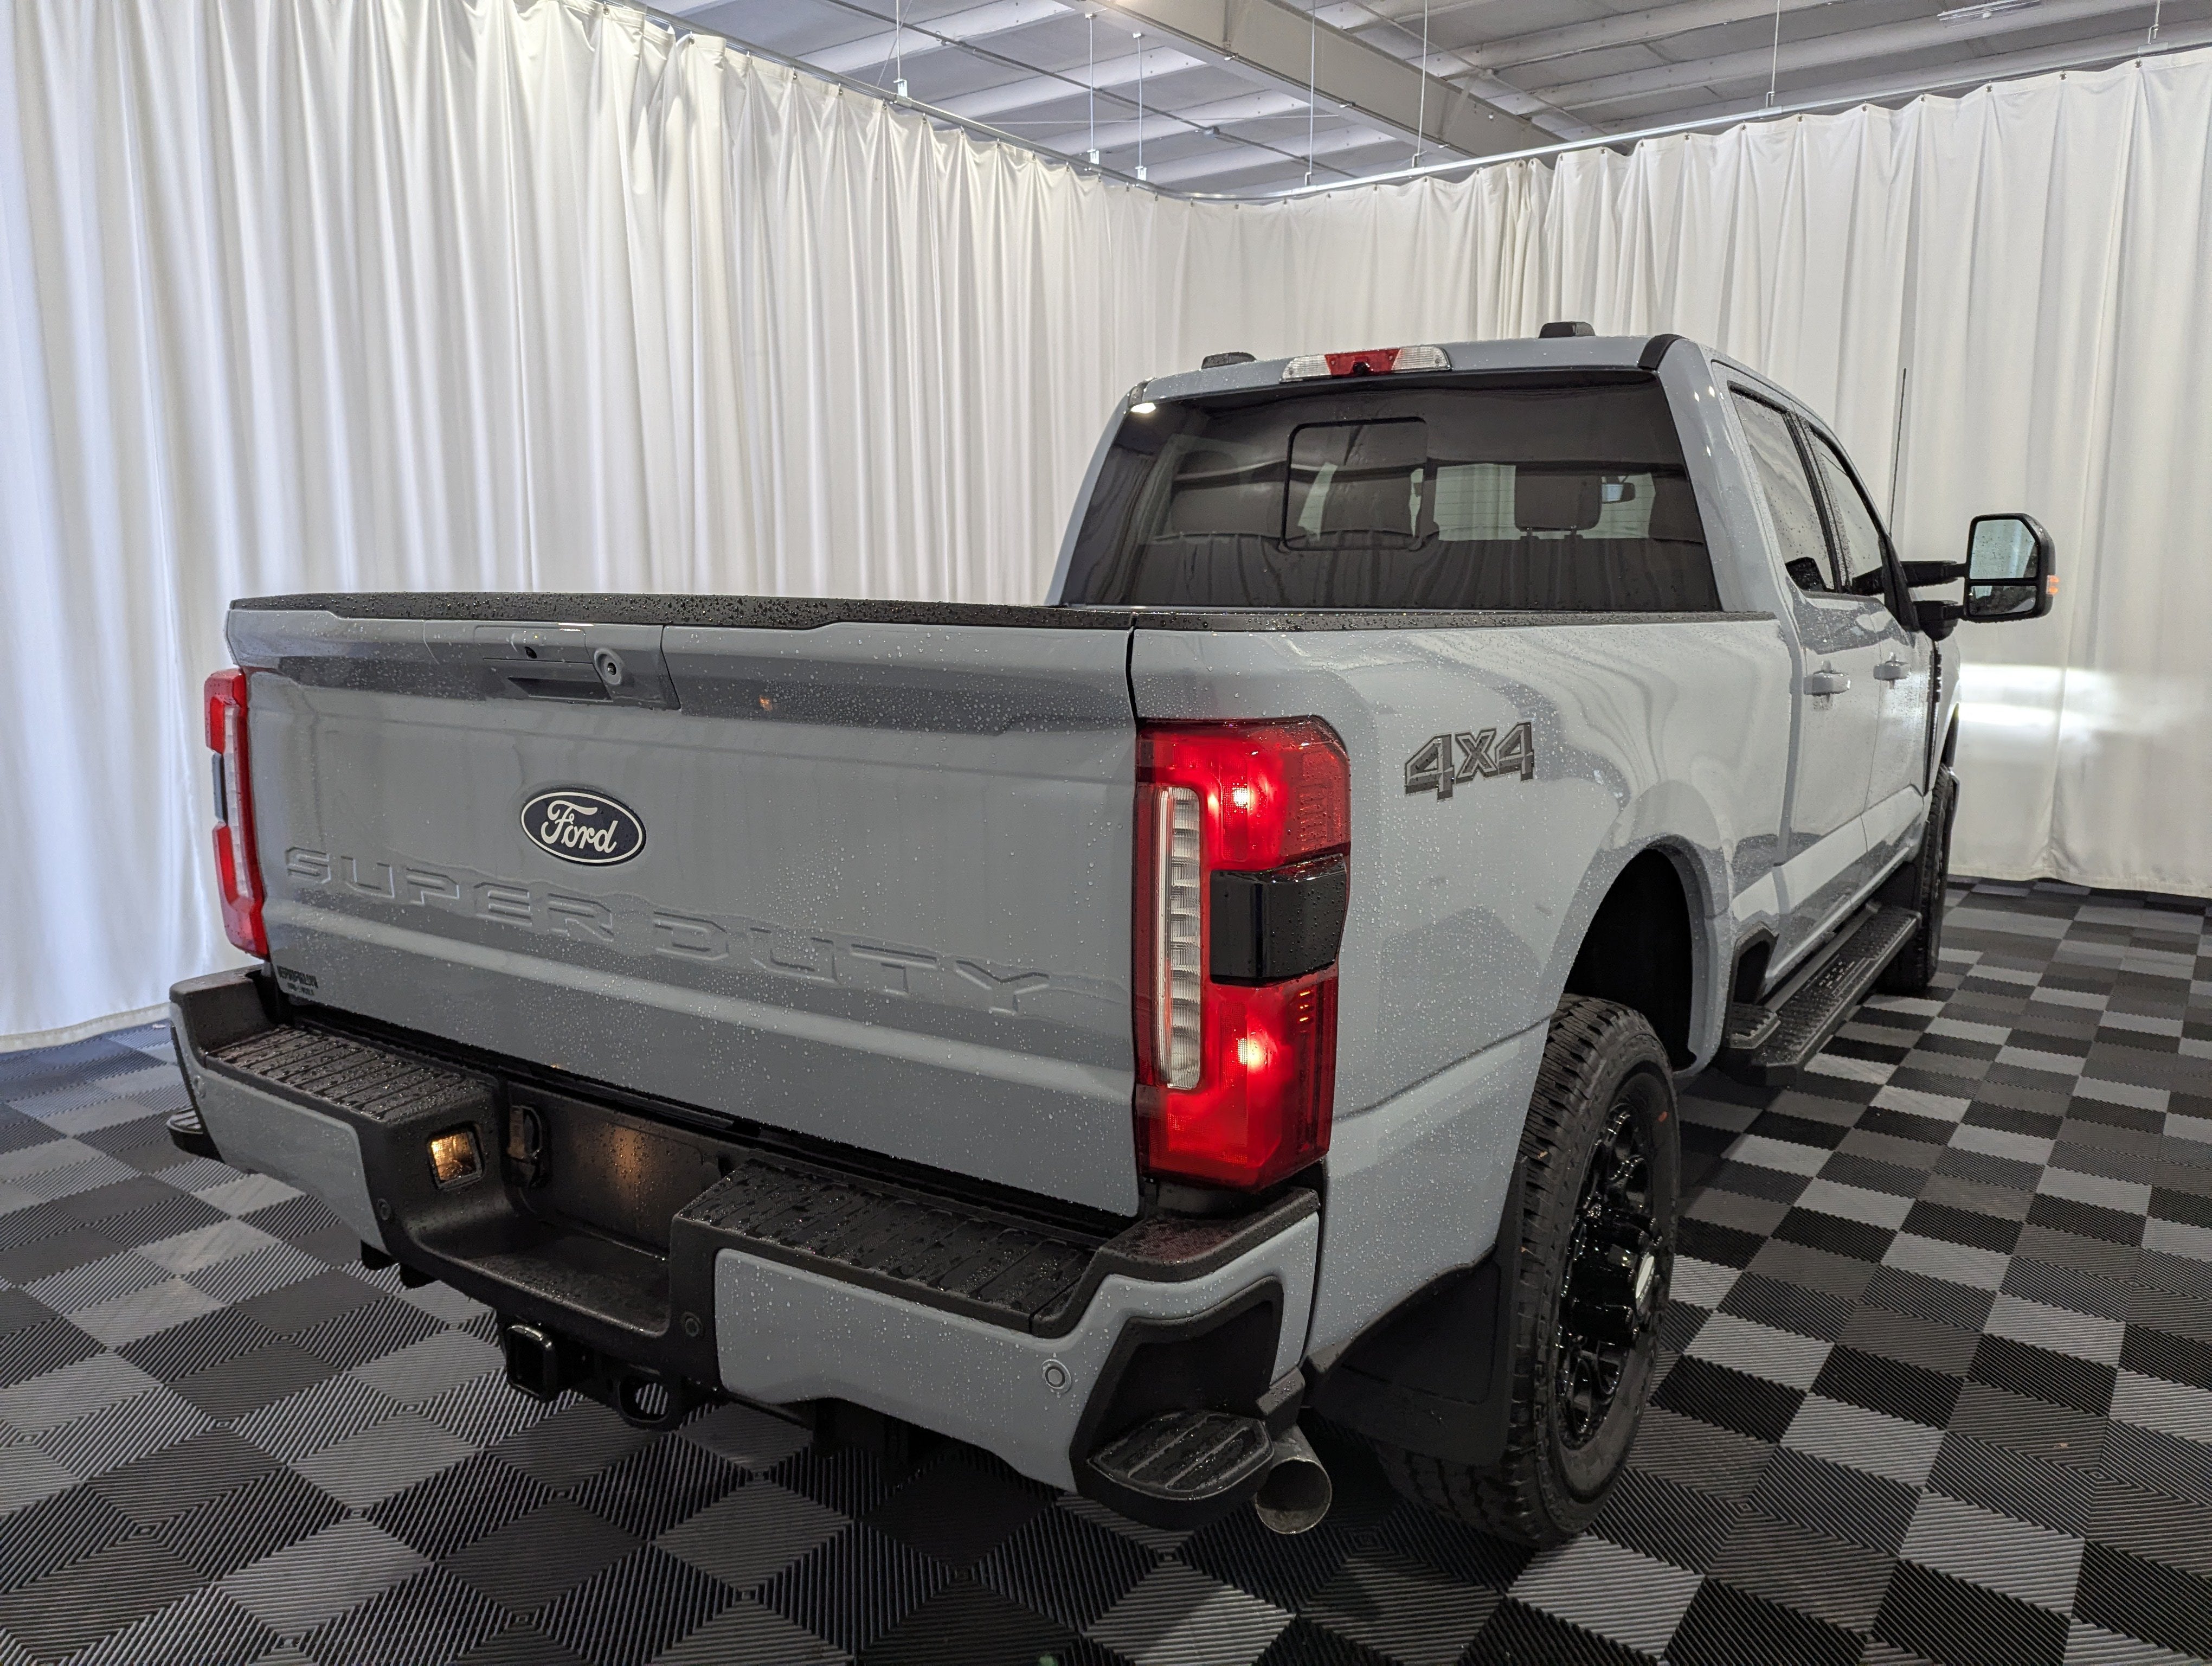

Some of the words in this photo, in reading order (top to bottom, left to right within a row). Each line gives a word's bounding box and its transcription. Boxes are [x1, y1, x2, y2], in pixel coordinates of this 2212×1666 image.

[541, 800, 619, 854] Ford
[285, 846, 614, 943] SUPER
[653, 909, 1050, 1016] DUTY
